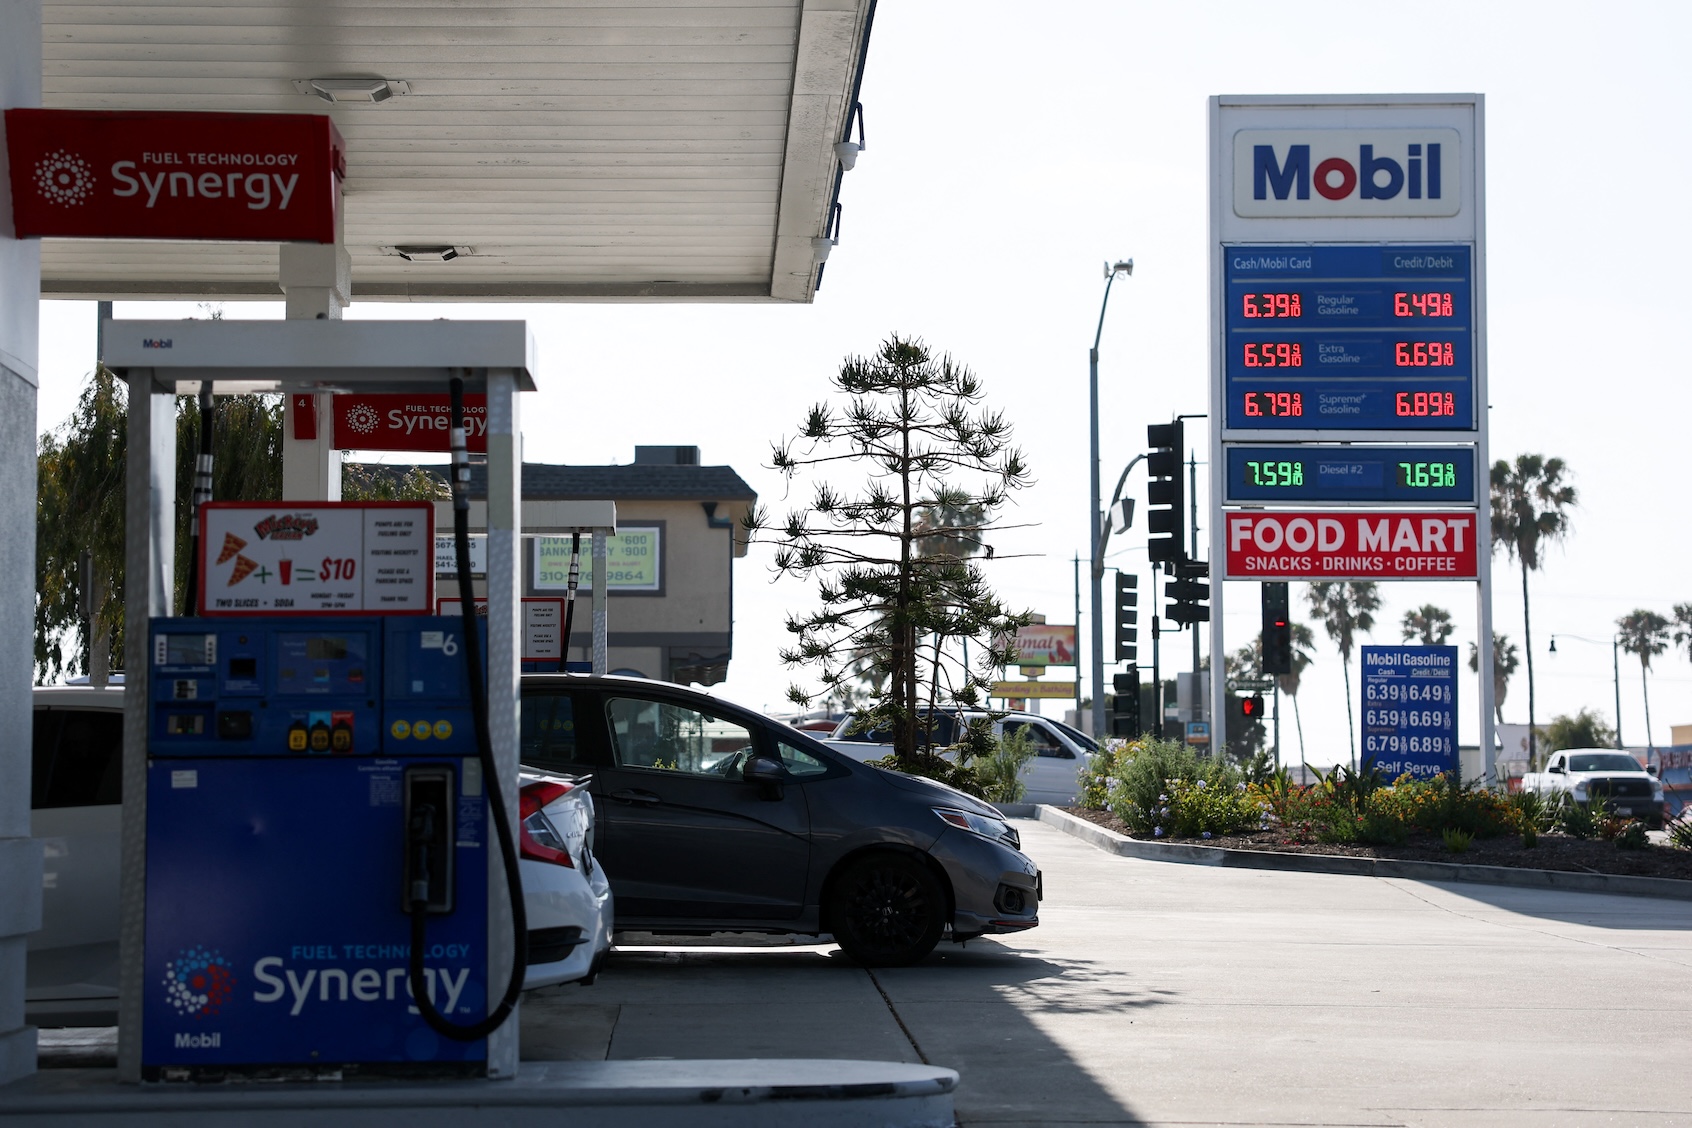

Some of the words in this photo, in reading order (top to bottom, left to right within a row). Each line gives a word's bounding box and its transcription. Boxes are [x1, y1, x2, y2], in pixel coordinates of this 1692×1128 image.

[142, 152, 183, 165] FUEL
[187, 153, 298, 166] TECHNOLOGY
[1253, 143, 1442, 201] Mobil
[111, 160, 299, 210] Synergy
[1234, 257, 1288, 270] Cash/Mobil
[1290, 256, 1312, 269] Card
[1393, 256, 1454, 269] Credit/Debit
[1243, 293, 1289, 318] 6.39
[1317, 294, 1355, 306] Regular
[1393, 292, 1441, 317] 6.49
[1317, 305, 1359, 315] Gasoline
[143, 338, 173, 349] Mobil
[1318, 344, 1345, 353] Extra
[1243, 343, 1290, 367] 6.59
[1319, 354, 1361, 363] Gasoline
[1395, 342, 1442, 367] 6.69
[298, 399, 306, 408] 4
[405, 404, 427, 412] FUEL
[1244, 392, 1290, 416] 6.79
[1319, 404, 1361, 414] Gasoline
[1396, 392, 1443, 416] 6.89
[387, 409, 487, 437] Synegy
[1246, 461, 1292, 486] 7.59
[1319, 464, 1349, 474] Diesel
[1350, 464, 1364, 474] #2
[1398, 462, 1444, 487] 7.69
[1230, 517, 1346, 553] FOOD
[1357, 518, 1470, 553] MART
[540, 547, 614, 556] BANKRPY
[319, 556, 356, 582] $10
[1245, 556, 1312, 571] SNACKS
[1322, 556, 1384, 571] DRINKS
[1394, 556, 1456, 571] COFFEE
[540, 571, 643, 581] 310-769864
[216, 599, 232, 607] TWO
[234, 599, 259, 607] SLICES
[274, 599, 294, 607] SODA
[443, 634, 459, 656] 6
[997, 636, 1054, 649] Aimal
[1366, 653, 1401, 666] Mobil
[1403, 653, 1451, 666] Gasoline
[993, 685, 1031, 695] oarding
[1366, 684, 1399, 700] 6.39
[1409, 685, 1442, 700] 6.49
[1366, 710, 1399, 726] 6.59
[1409, 711, 1442, 726] 6.69
[1366, 736, 1399, 751] 6.79
[1409, 737, 1442, 752] 6.89
[1376, 760, 1401, 773] Self
[1404, 761, 1441, 774] Serve
[291, 945, 338, 960] FUEL
[253, 956, 471, 1017] Synergy
[174, 1032, 221, 1048] Mobil
